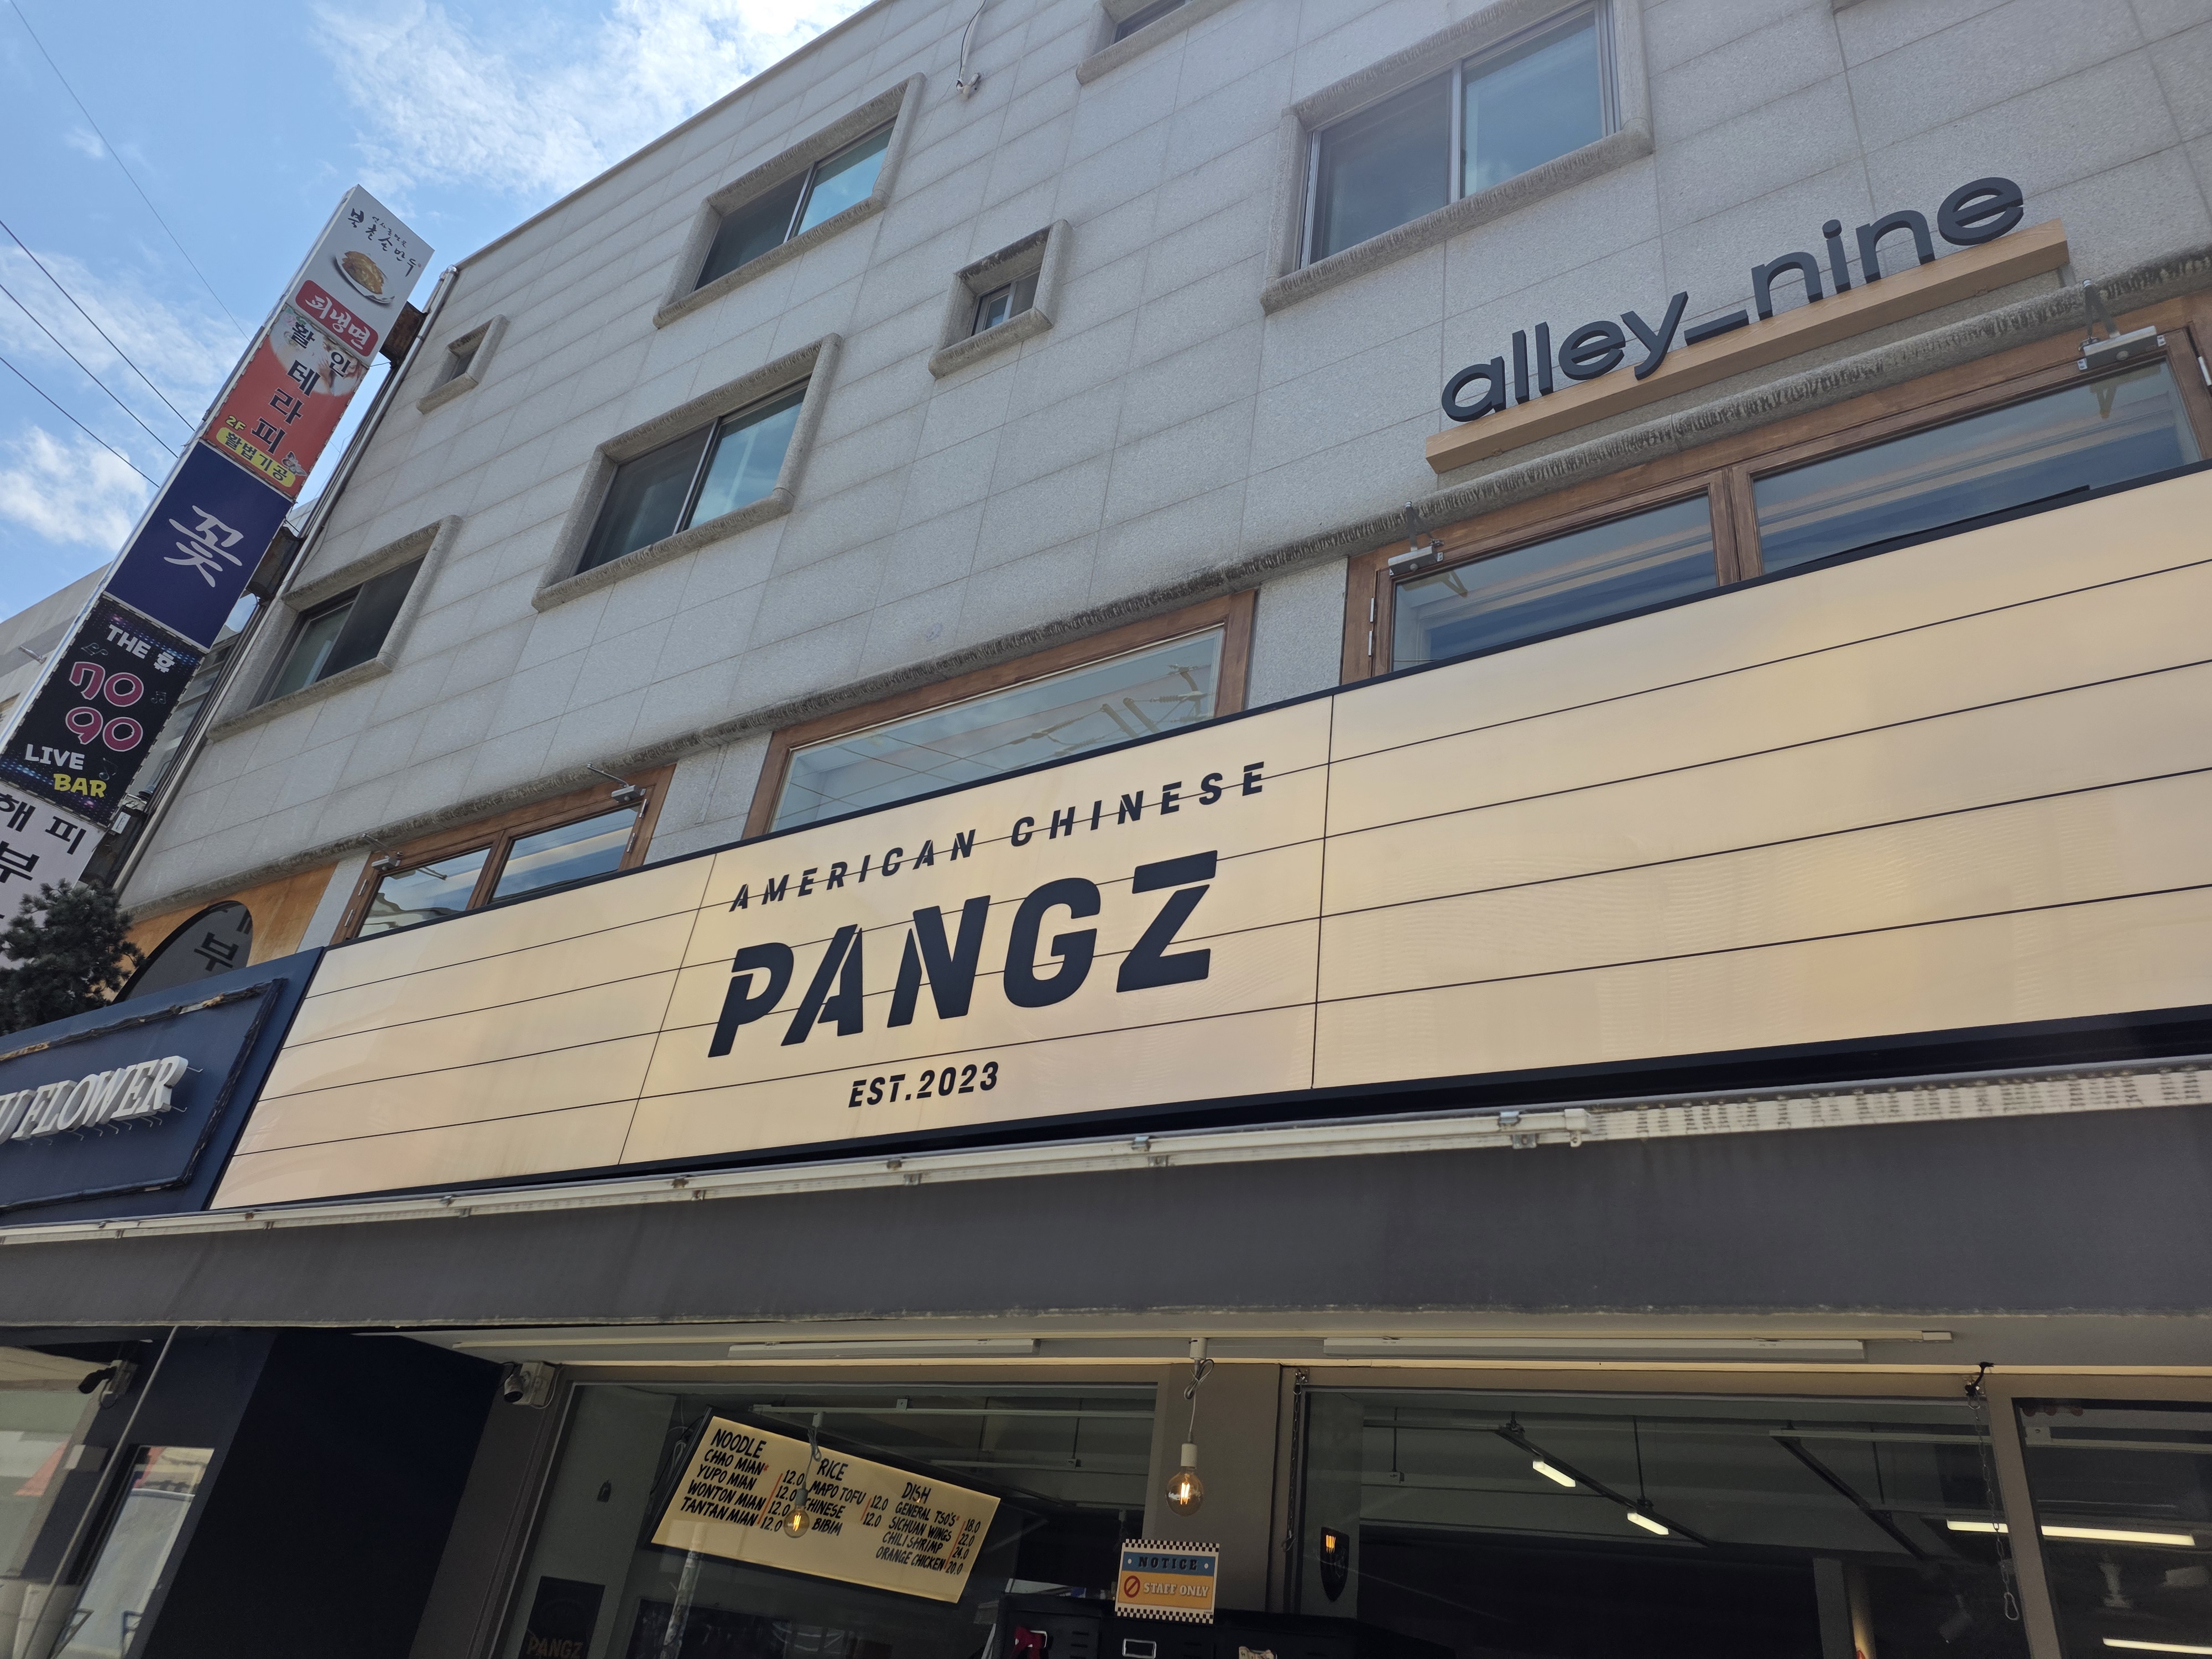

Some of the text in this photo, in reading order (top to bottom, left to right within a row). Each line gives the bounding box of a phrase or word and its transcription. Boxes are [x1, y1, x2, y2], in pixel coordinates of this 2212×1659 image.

[347, 208, 417, 277] 북촌손만두
[1440, 176, 2025, 422] alley_nine
[305, 295, 371, 350] 피냉면
[225, 415, 246, 431] 2F
[225, 431, 288, 481] 활법기공
[164, 505, 244, 588] 꽃
[106, 624, 152, 659] THE
[69, 661, 144, 707] 70
[65, 707, 143, 752] 90
[25, 744, 85, 770] LIVE
[53, 773, 107, 797] BAR
[729, 760, 1265, 912] AMERICAN CHINESE
[707, 850, 1218, 1058] PANGZ
[848, 1061, 999, 1108] EST.2023
[710, 1428, 767, 1459] NOODLE
[696, 1464, 797, 1502] YUPO MIAN 12.0
[704, 1448, 734, 1467] CHAO
[782, 1469, 805, 1486] 12.0
[816, 1458, 849, 1481] RICE
[687, 1479, 791, 1517] WONTON MIAN 12.0
[808, 1480, 889, 1511] MAPO TOFU 12.0
[901, 1481, 932, 1504] DISH
[680, 1496, 783, 1532] TANTAN MIAN 12.0
[811, 1518, 843, 1536] BIBIM
[862, 1512, 882, 1527] 12.0
[895, 1501, 931, 1521] GENERAL
[964, 1518, 981, 1533] 18.0
[882, 1531, 969, 1560] CHILI SHRIMP 24.0
[888, 1516, 975, 1547] SICHUAN WINGS 22.0
[875, 1546, 964, 1575] ORANGE CHICKEN 20.0
[1138, 1557, 1198, 1571] NOTICE
[1143, 1582, 1209, 1597] STAFF ONLY
